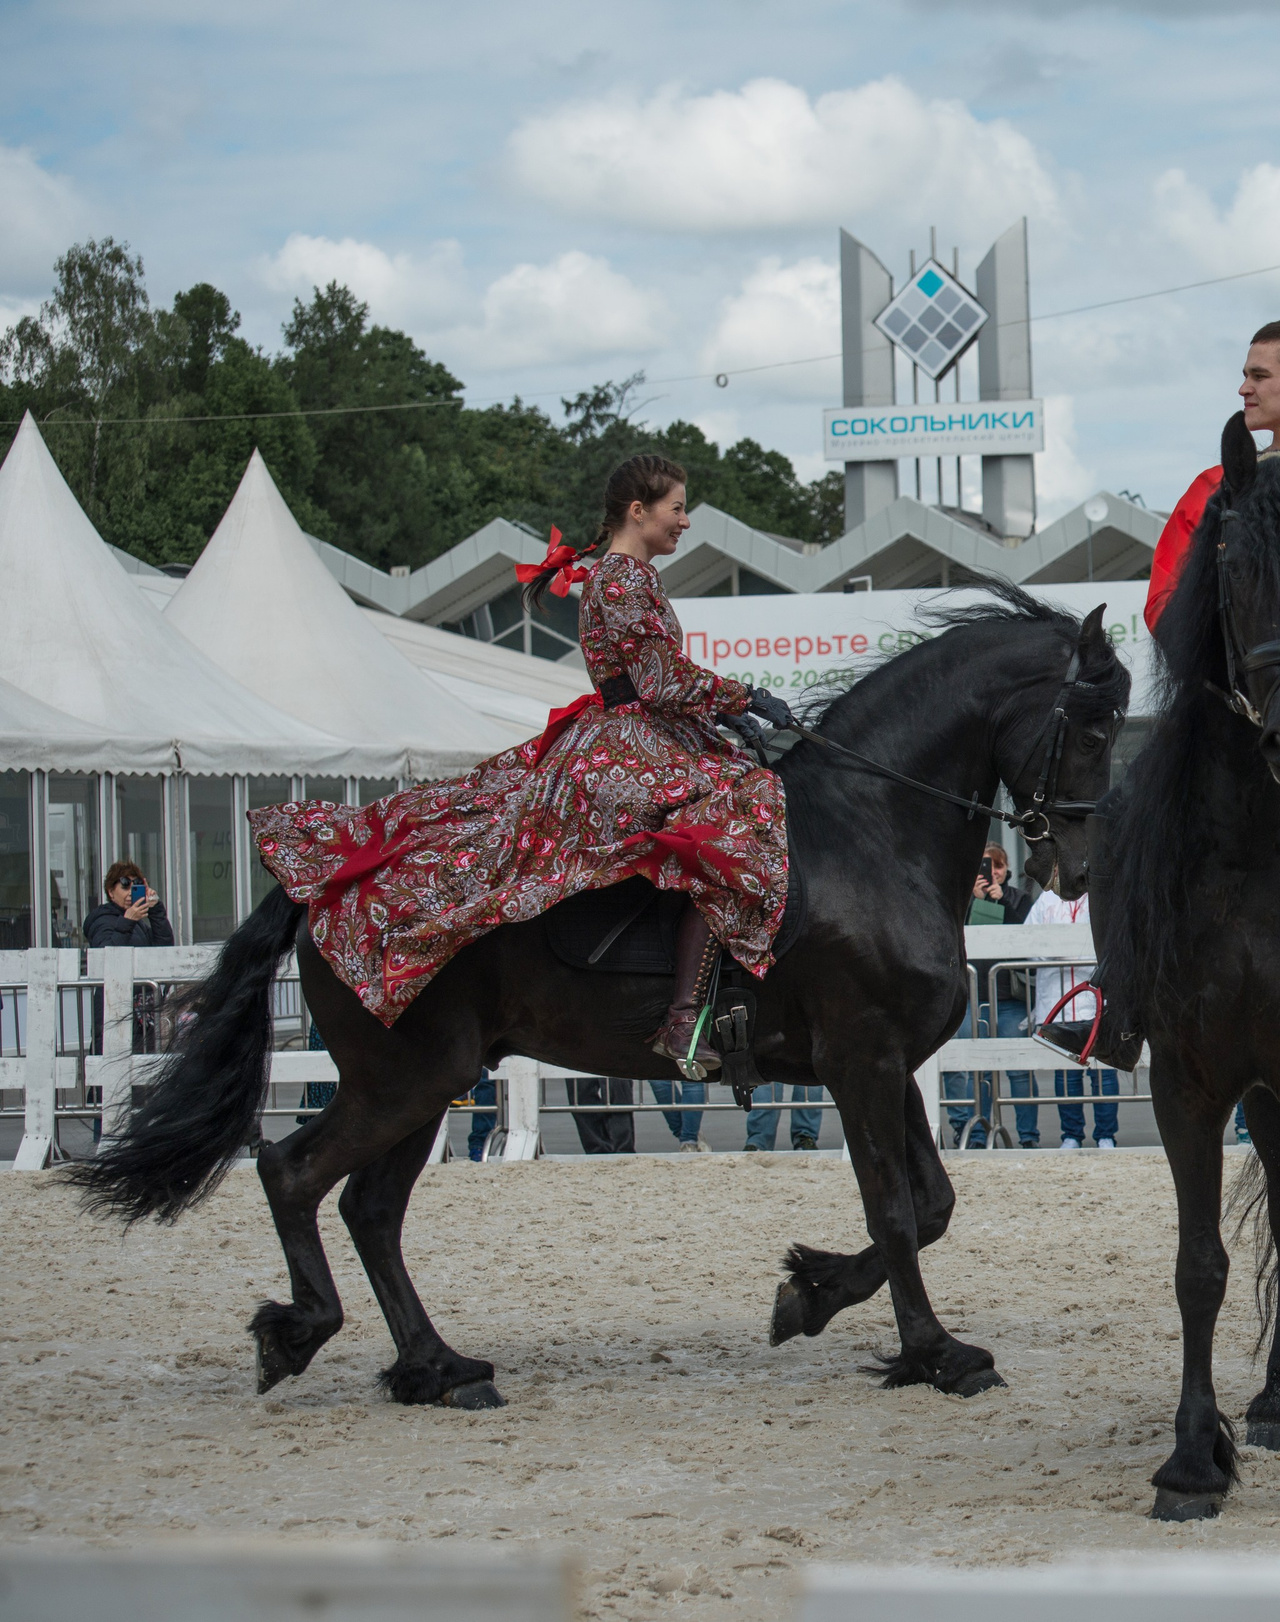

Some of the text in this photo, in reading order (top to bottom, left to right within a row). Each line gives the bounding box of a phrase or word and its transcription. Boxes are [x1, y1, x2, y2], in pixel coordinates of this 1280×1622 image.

[831, 411, 1035, 436] СОКОЛЬНИКИ
[686, 632, 868, 666] Проверьте
[760, 671, 785, 687] до
